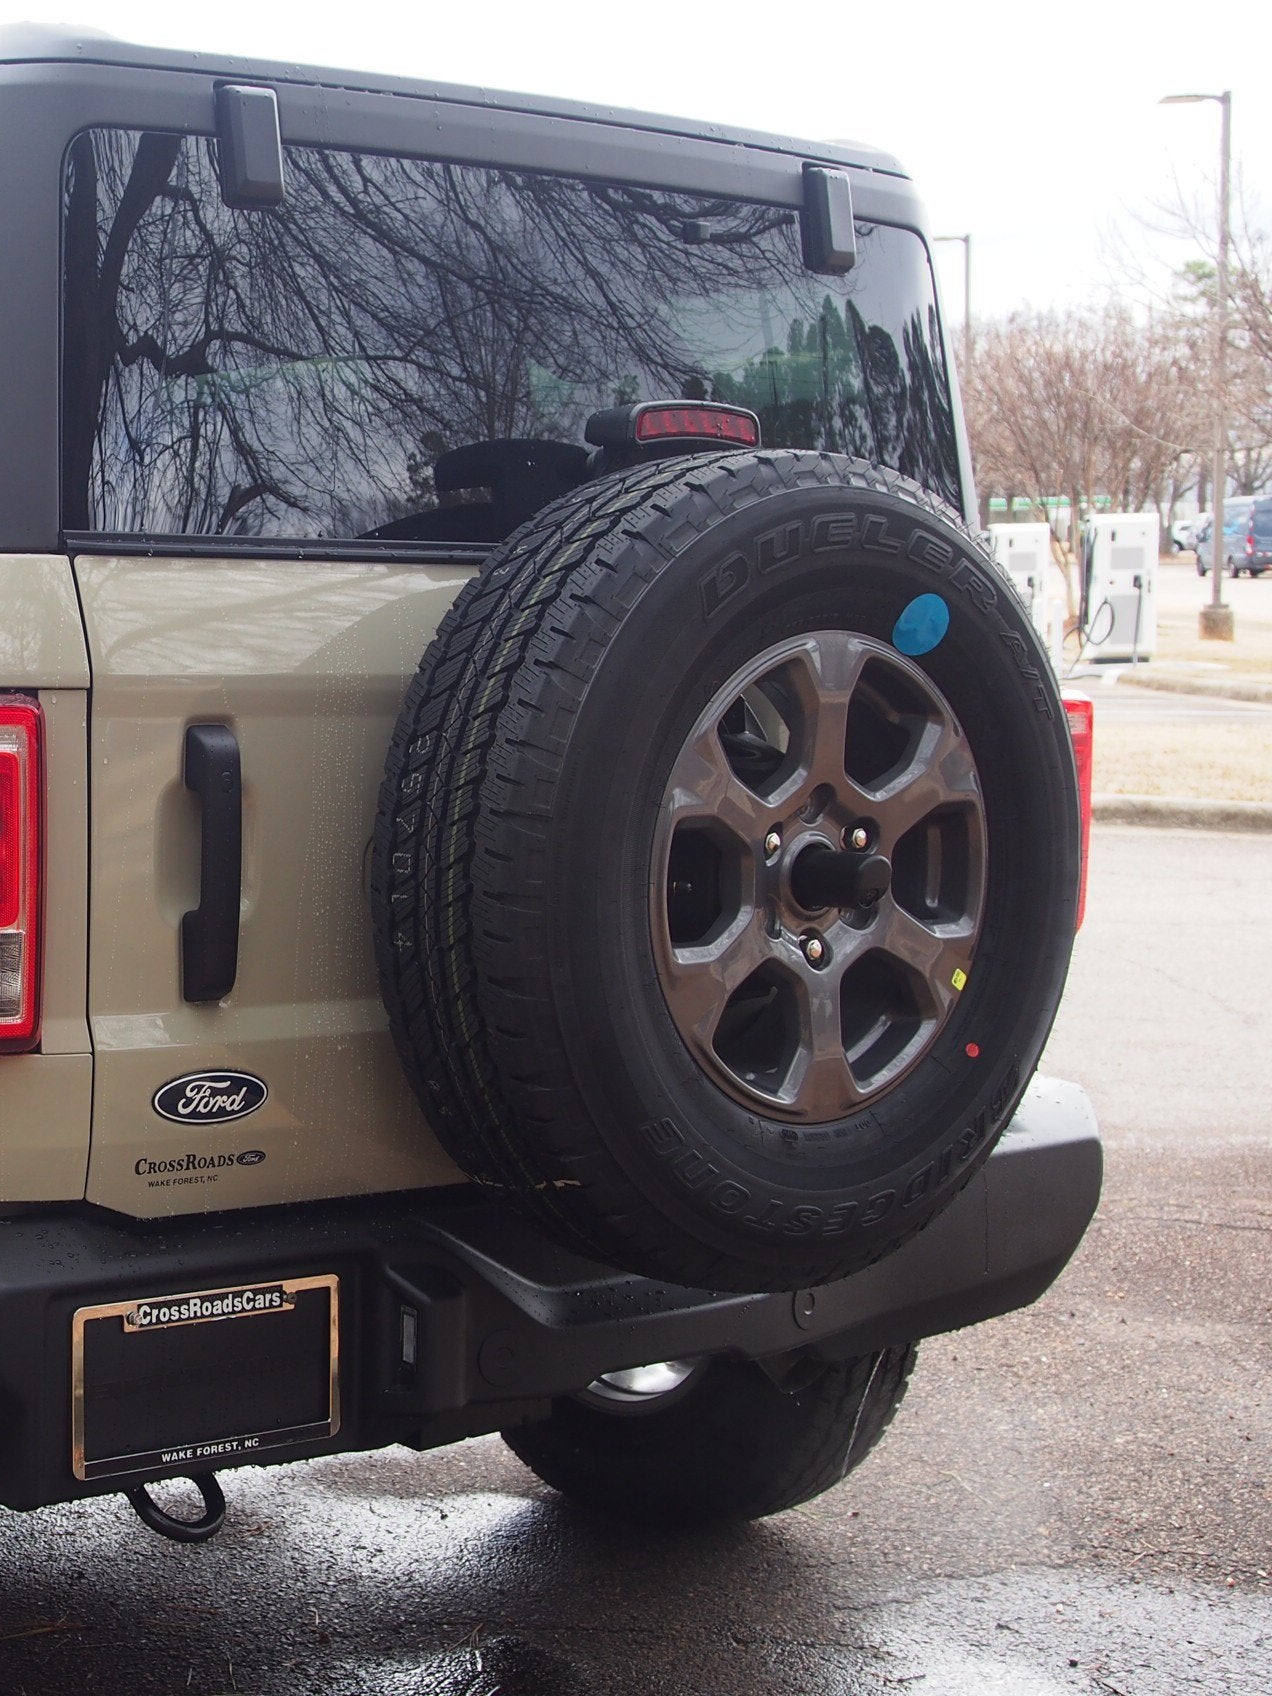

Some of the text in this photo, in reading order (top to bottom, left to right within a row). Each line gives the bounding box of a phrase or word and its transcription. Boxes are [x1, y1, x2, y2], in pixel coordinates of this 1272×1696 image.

[699, 511, 998, 622] DUELER
[177, 1080, 247, 1115] Ford
[641, 1062, 1022, 1236] BRIDGESTONE
[147, 1174, 218, 1188] WAKE FOREST, NC
[138, 1291, 281, 1325] CrossRoadsCars
[161, 1437, 260, 1463] WAKE FOREST, NC
